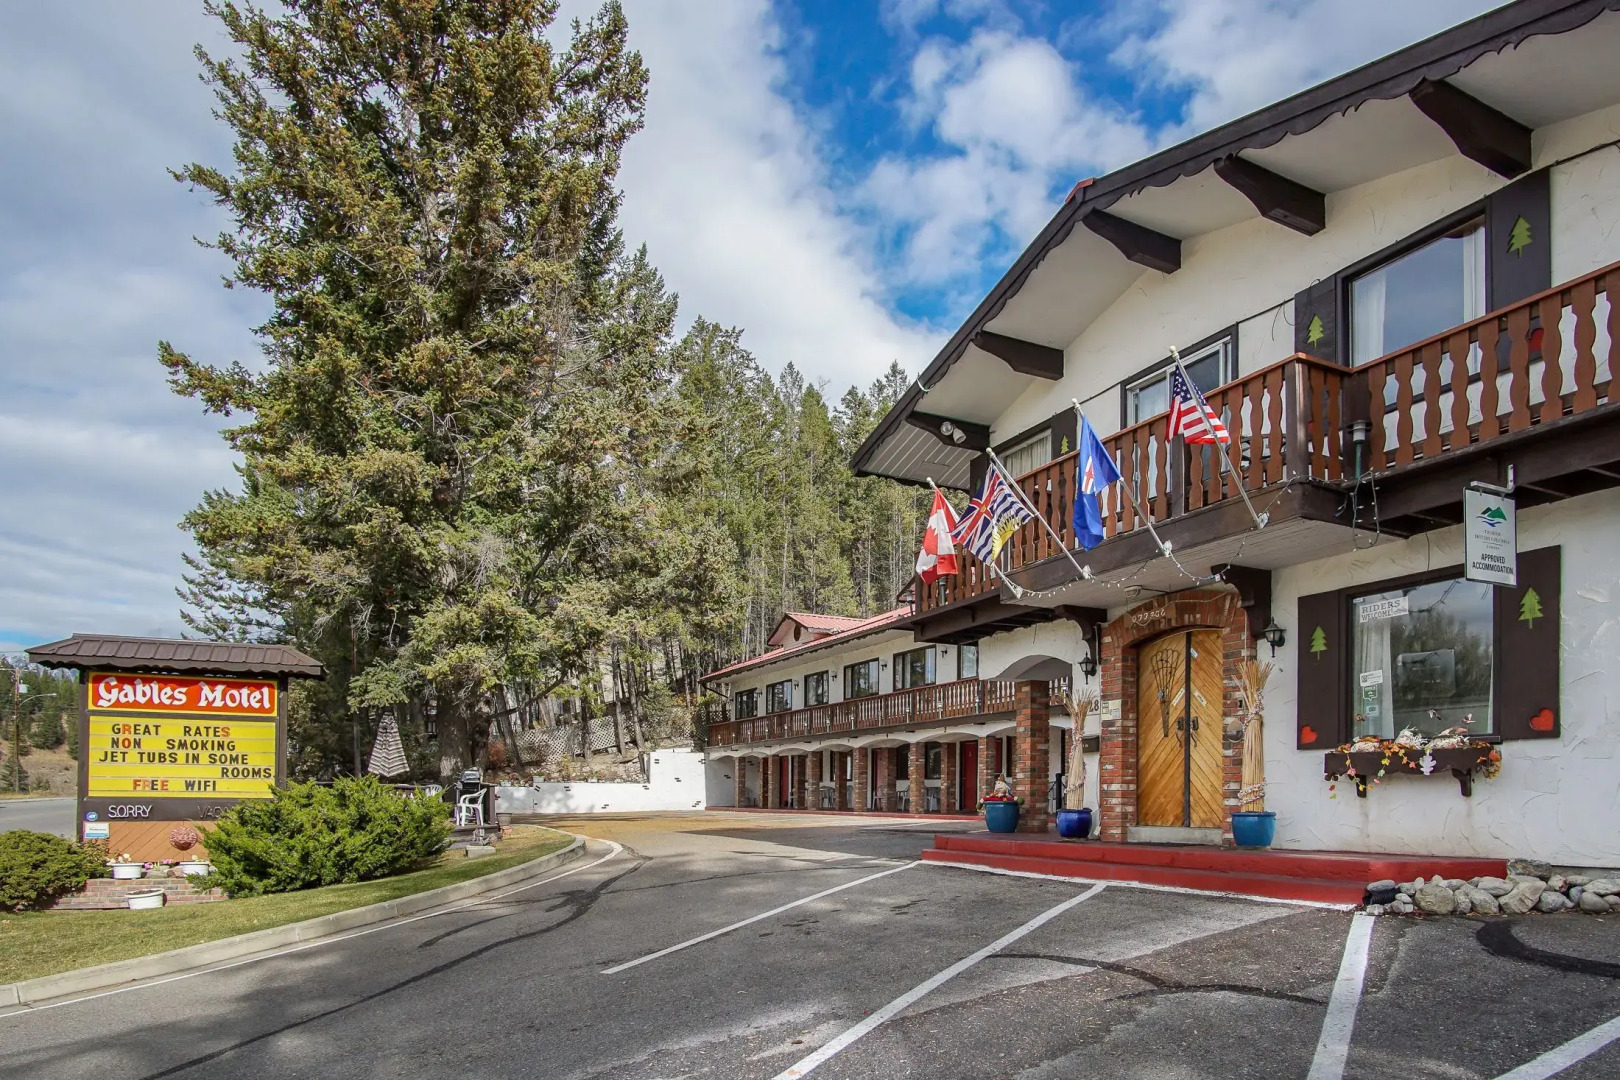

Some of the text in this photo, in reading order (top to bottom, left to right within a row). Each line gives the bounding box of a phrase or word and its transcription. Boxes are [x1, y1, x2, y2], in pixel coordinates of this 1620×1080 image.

[1481, 553, 1505, 564] APPROVED
[1472, 561, 1514, 574] ACCOMMODATION
[1361, 600, 1401, 614] RIDERS
[97, 677, 271, 709] Gables Motel
[111, 723, 231, 738] GREAT RATES
[111, 737, 236, 751] NON SMOKING
[99, 750, 249, 765] JET TUBS IN SOME
[132, 779, 217, 792] FREE WIFI
[108, 804, 152, 818] SORRY
